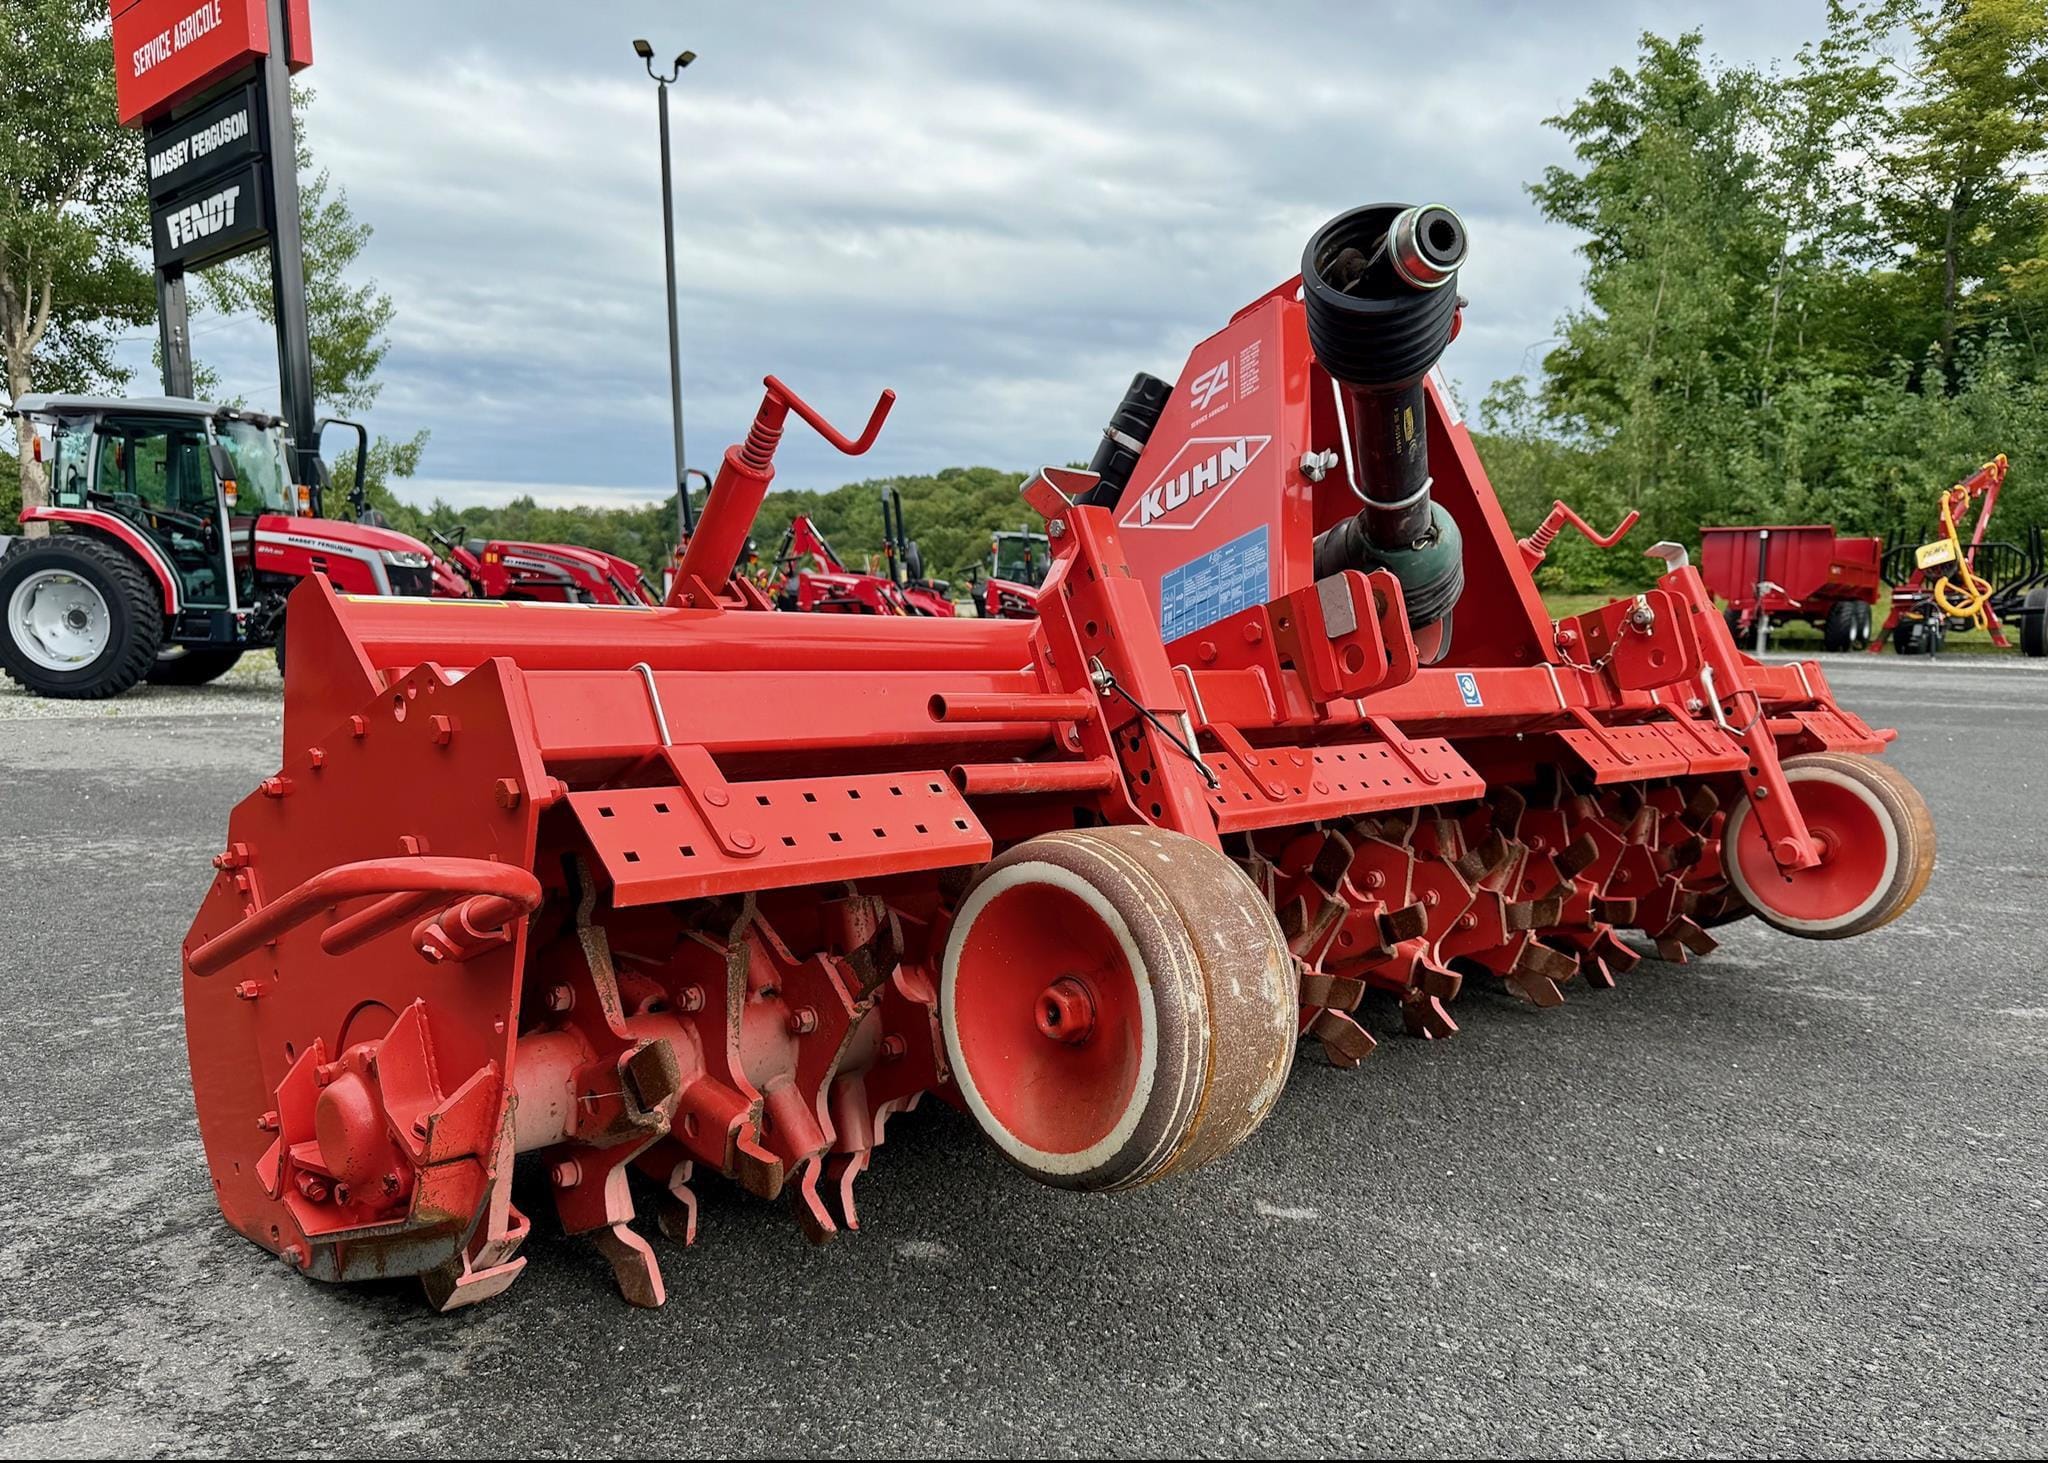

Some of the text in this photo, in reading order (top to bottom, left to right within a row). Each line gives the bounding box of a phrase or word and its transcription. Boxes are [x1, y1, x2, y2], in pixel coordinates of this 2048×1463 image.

[133, 0, 222, 78] SERVICE AGRICOLE
[150, 110, 248, 180] MASSEY FERGUSON
[166, 185, 240, 250] FENDT
[1140, 438, 1247, 526] KUHN
[288, 536, 353, 554] MASSEY FERGUSON
